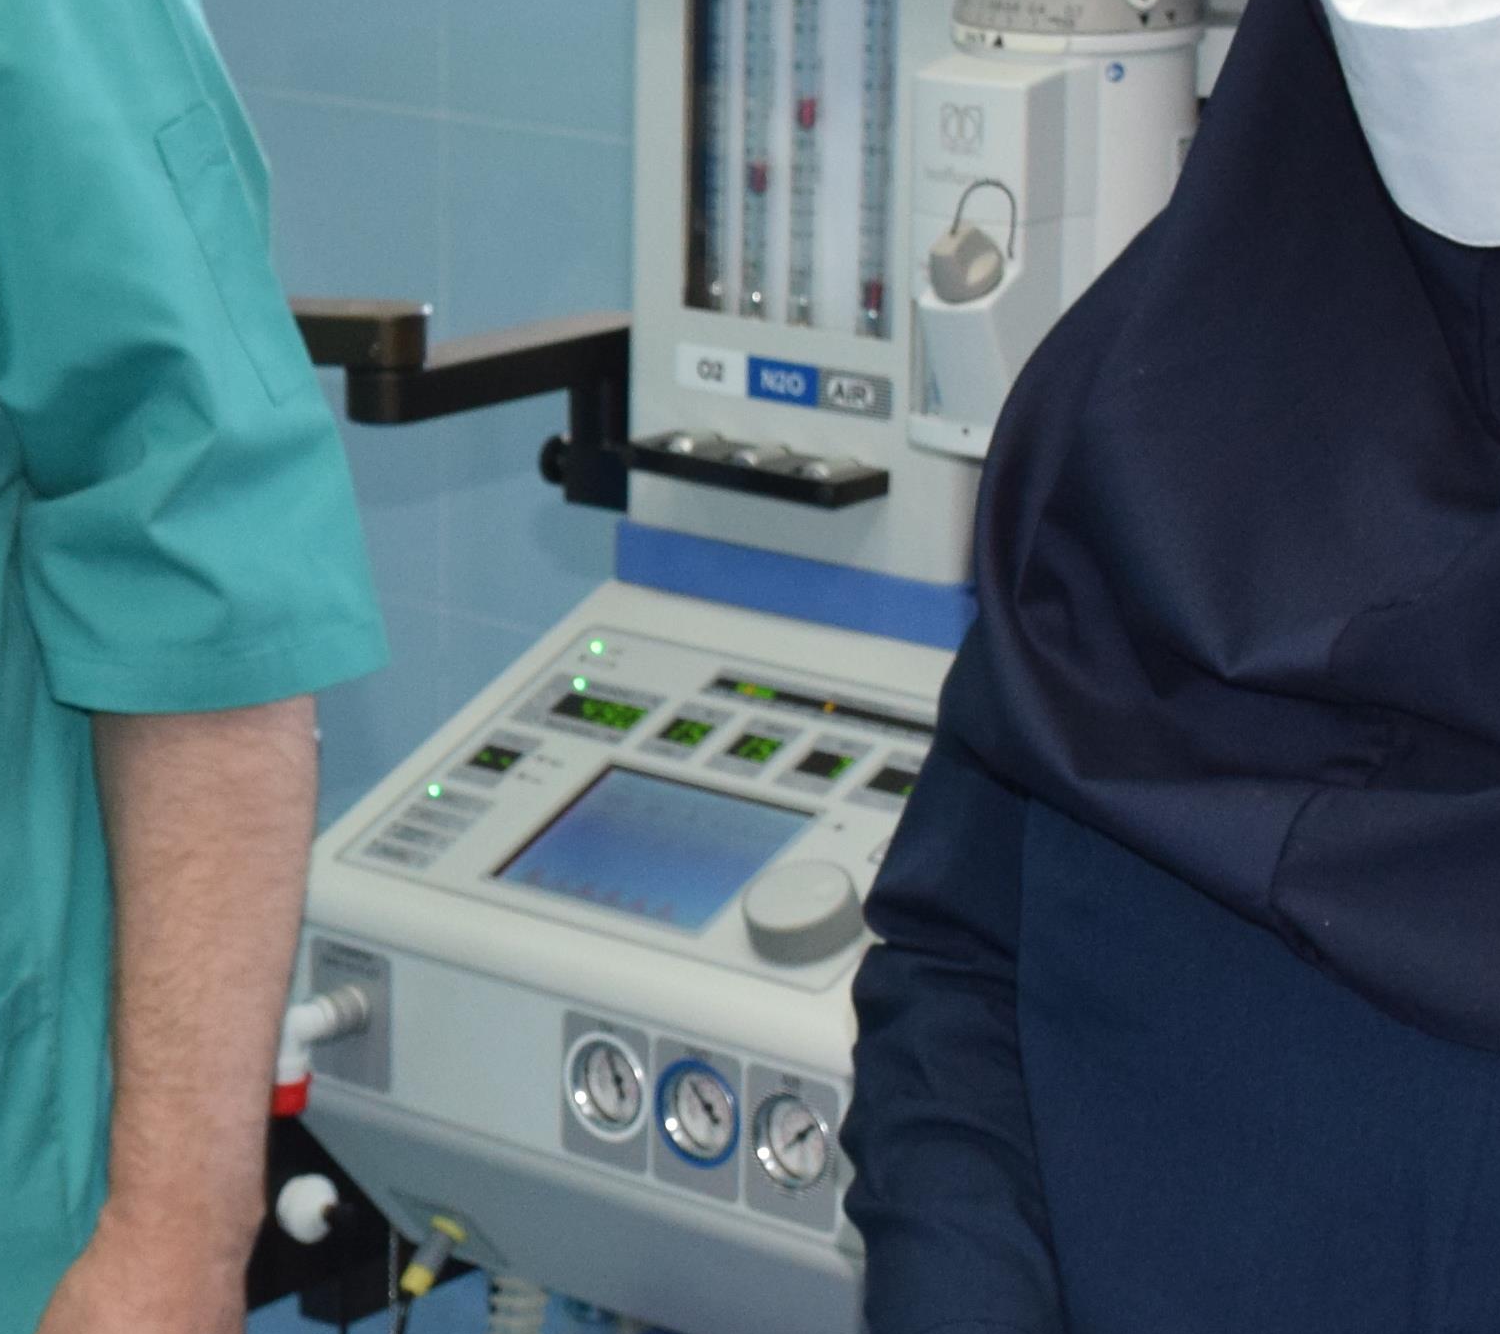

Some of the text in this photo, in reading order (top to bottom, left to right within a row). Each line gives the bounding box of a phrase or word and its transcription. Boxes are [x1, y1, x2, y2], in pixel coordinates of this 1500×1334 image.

[696, 356, 870, 405] O2 N2O AIR
